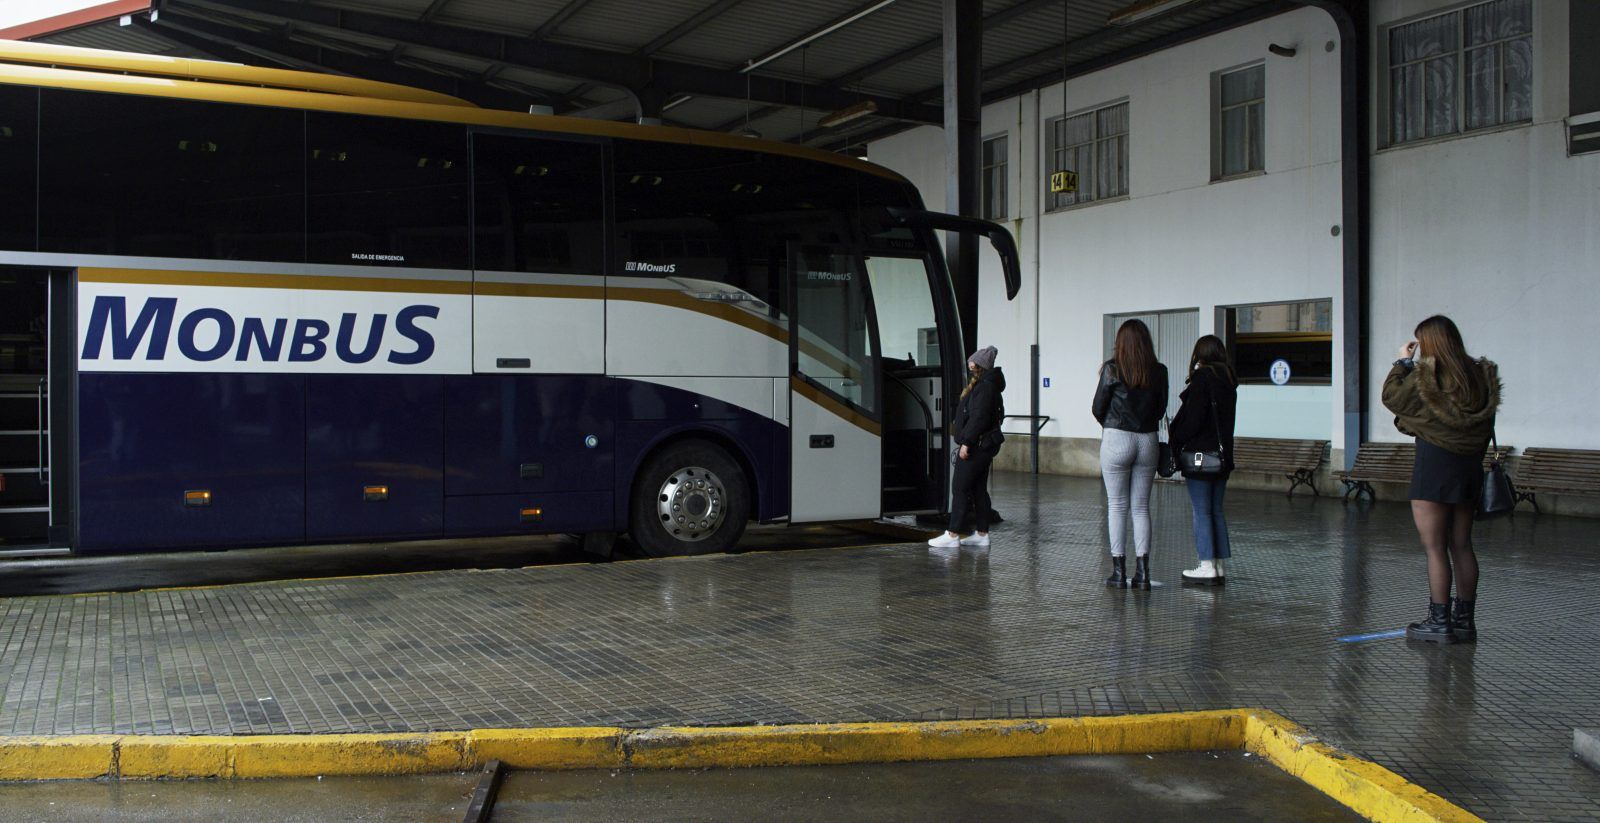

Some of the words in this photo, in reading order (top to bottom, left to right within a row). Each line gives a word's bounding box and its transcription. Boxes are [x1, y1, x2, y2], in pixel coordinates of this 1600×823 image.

[1053, 173, 1062, 190] 14
[1065, 173, 1076, 189] 14
[637, 262, 676, 273] MONBUS
[81, 295, 441, 365] MONBUS
